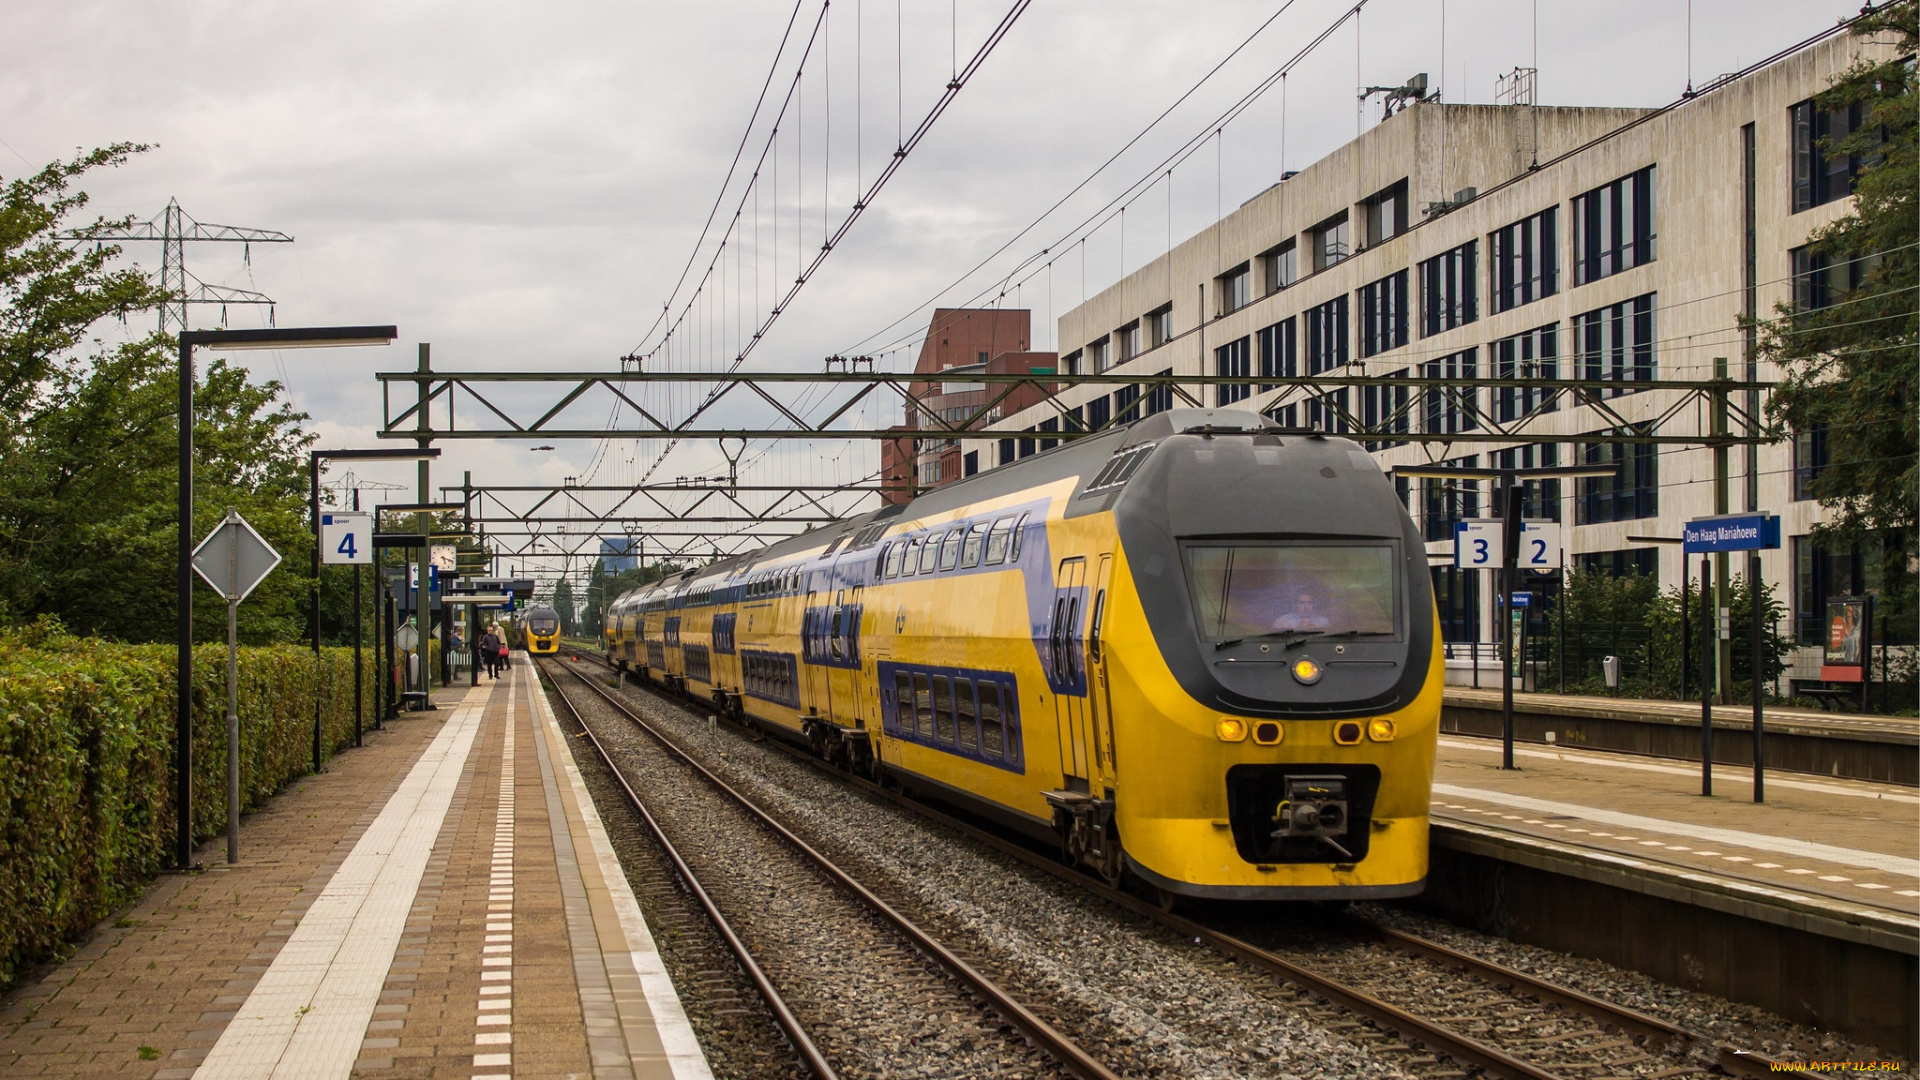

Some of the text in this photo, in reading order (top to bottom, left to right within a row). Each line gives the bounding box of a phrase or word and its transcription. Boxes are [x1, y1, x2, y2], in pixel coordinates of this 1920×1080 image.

[337, 532, 357, 559] 4
[1686, 525, 1757, 545] Den Haag Mariahoeve
[1473, 539, 1489, 564] 3
[1531, 539, 1547, 564] 2
